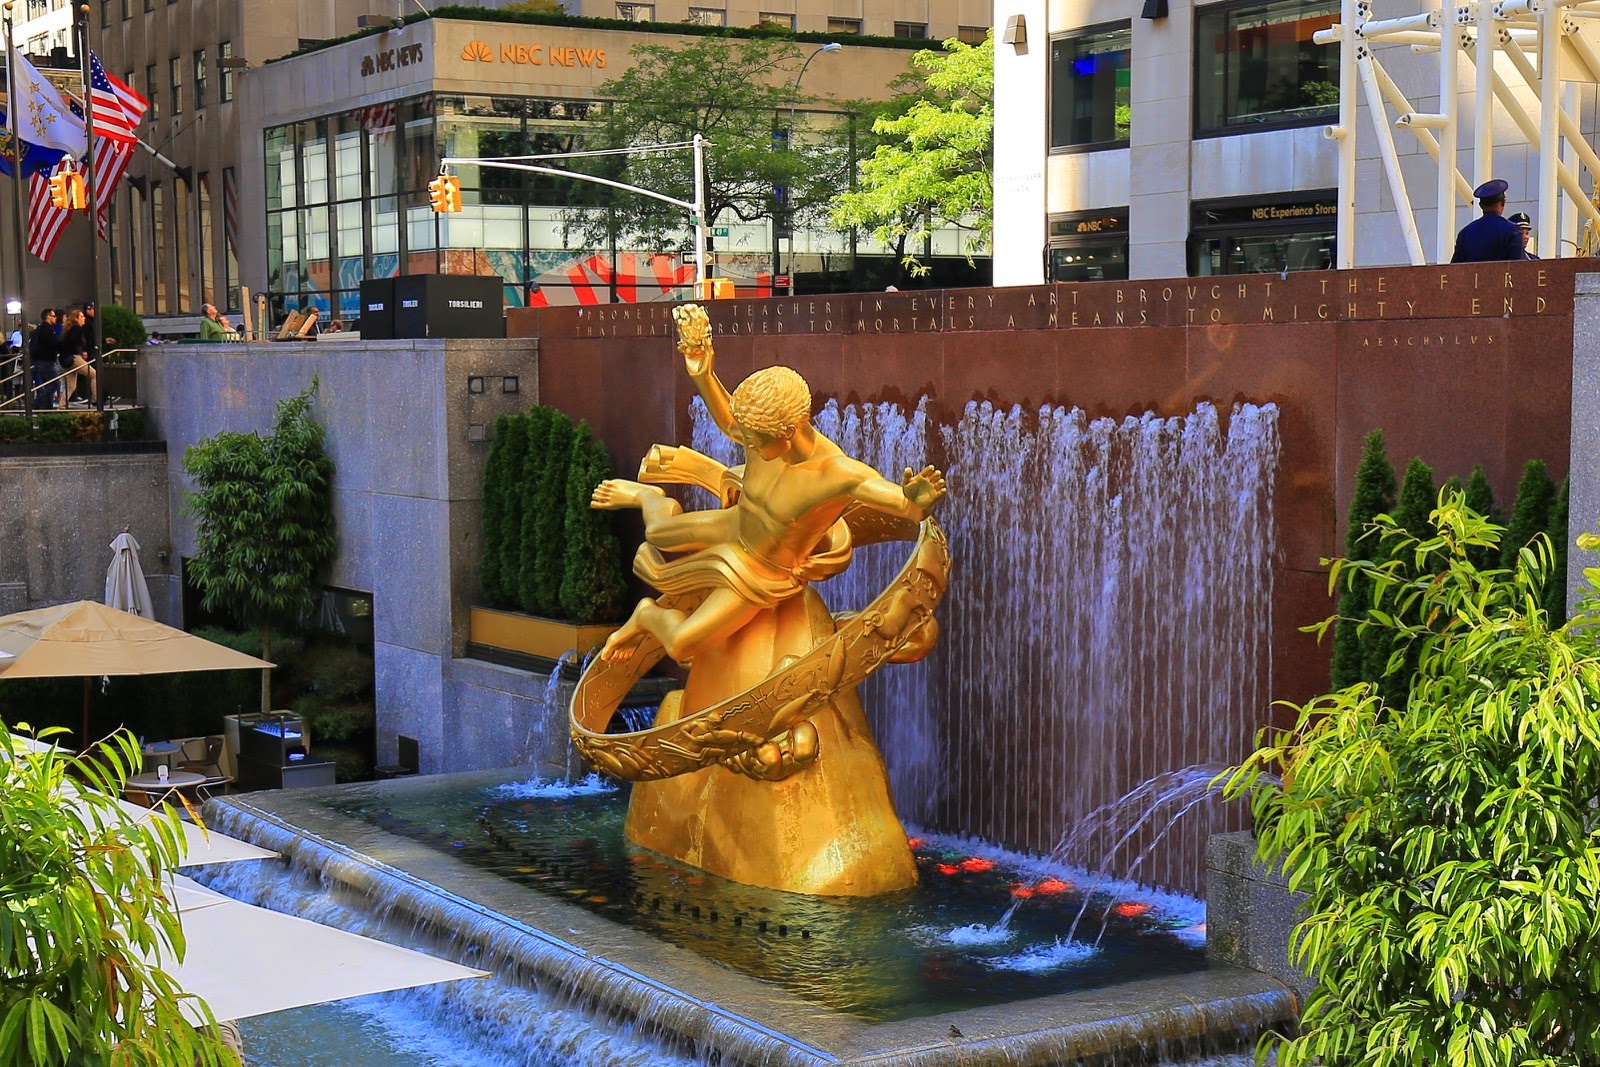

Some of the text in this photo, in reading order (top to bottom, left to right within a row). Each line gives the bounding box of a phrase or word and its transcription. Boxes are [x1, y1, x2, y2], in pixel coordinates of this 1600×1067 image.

[376, 42, 424, 74] NBC NEWS
[500, 42, 608, 69] NBC NEWS
[1252, 203, 1337, 220] NBC Experience Store
[1087, 220, 1103, 232] NBC
[448, 300, 484, 309] TORSILIERI
[587, 305, 709, 321] PROMETH
[732, 301, 832, 316] TEACHER
[859, 299, 883, 313] IN
[911, 294, 996, 311] EVERY
[1028, 290, 1079, 307] ART
[1319, 277, 1387, 296] THE
[1440, 270, 1547, 290] FIRE
[576, 296, 1547, 337] THAT HAT ROVED TO MORTALS A MEANS TO MIGHTY END
